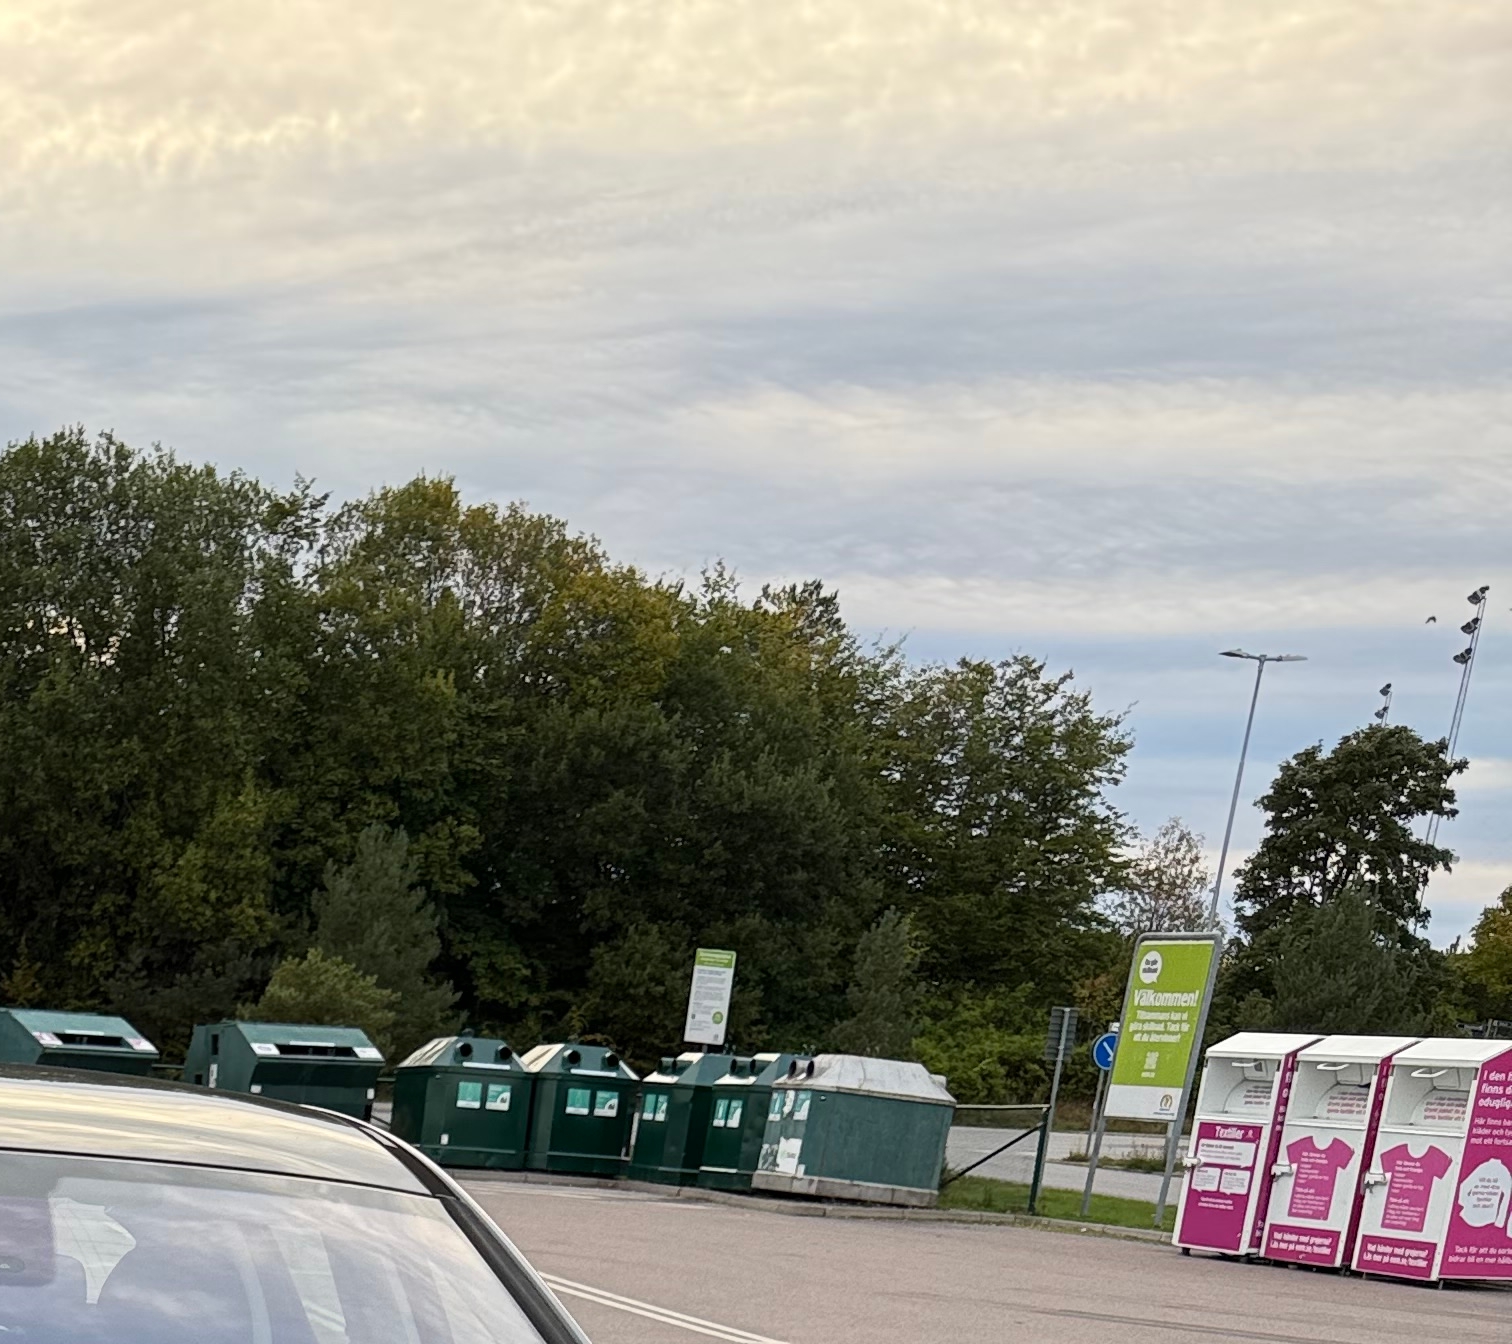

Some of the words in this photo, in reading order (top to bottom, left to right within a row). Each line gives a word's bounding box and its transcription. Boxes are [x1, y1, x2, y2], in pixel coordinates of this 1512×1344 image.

[1134, 988, 1199, 1007] Välkommen!
[1489, 1071, 1506, 1081] den
[1481, 1082, 1504, 1094] finns
